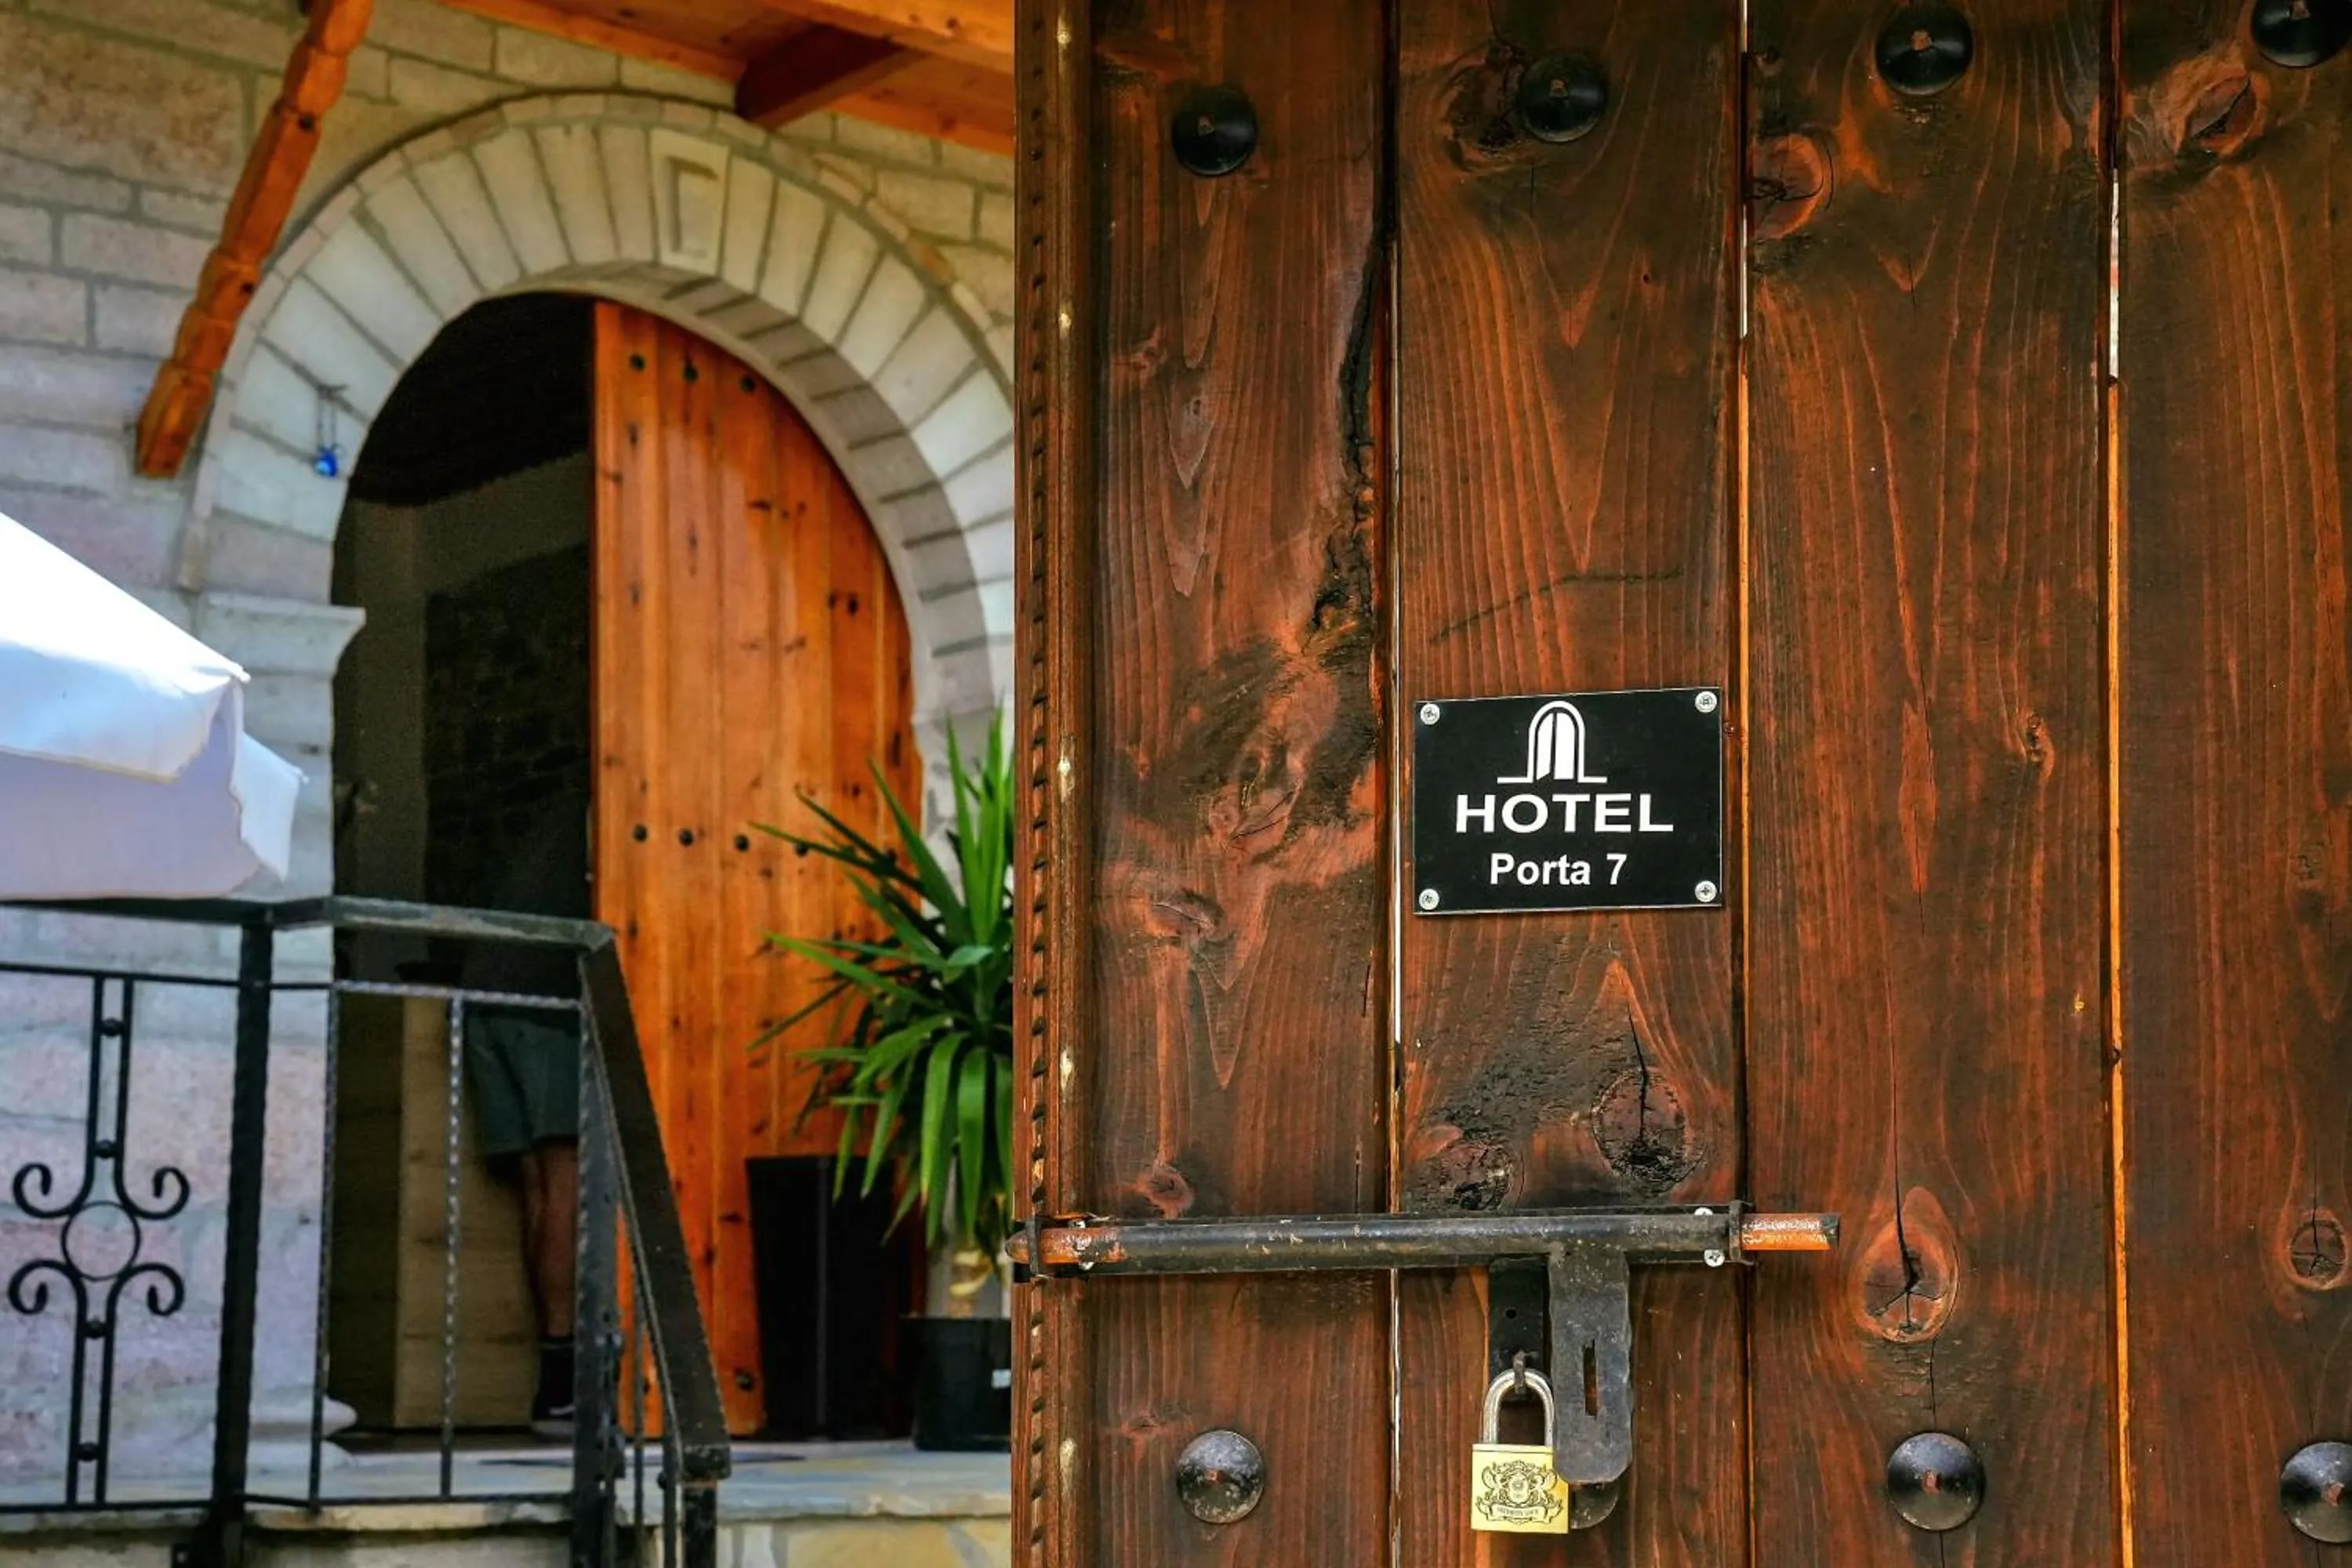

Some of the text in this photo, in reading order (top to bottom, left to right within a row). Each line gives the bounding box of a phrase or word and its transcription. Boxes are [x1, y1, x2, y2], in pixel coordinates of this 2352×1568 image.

[1455, 793, 1674, 833] HOTEL
[1490, 852, 1628, 885] Porta 7
